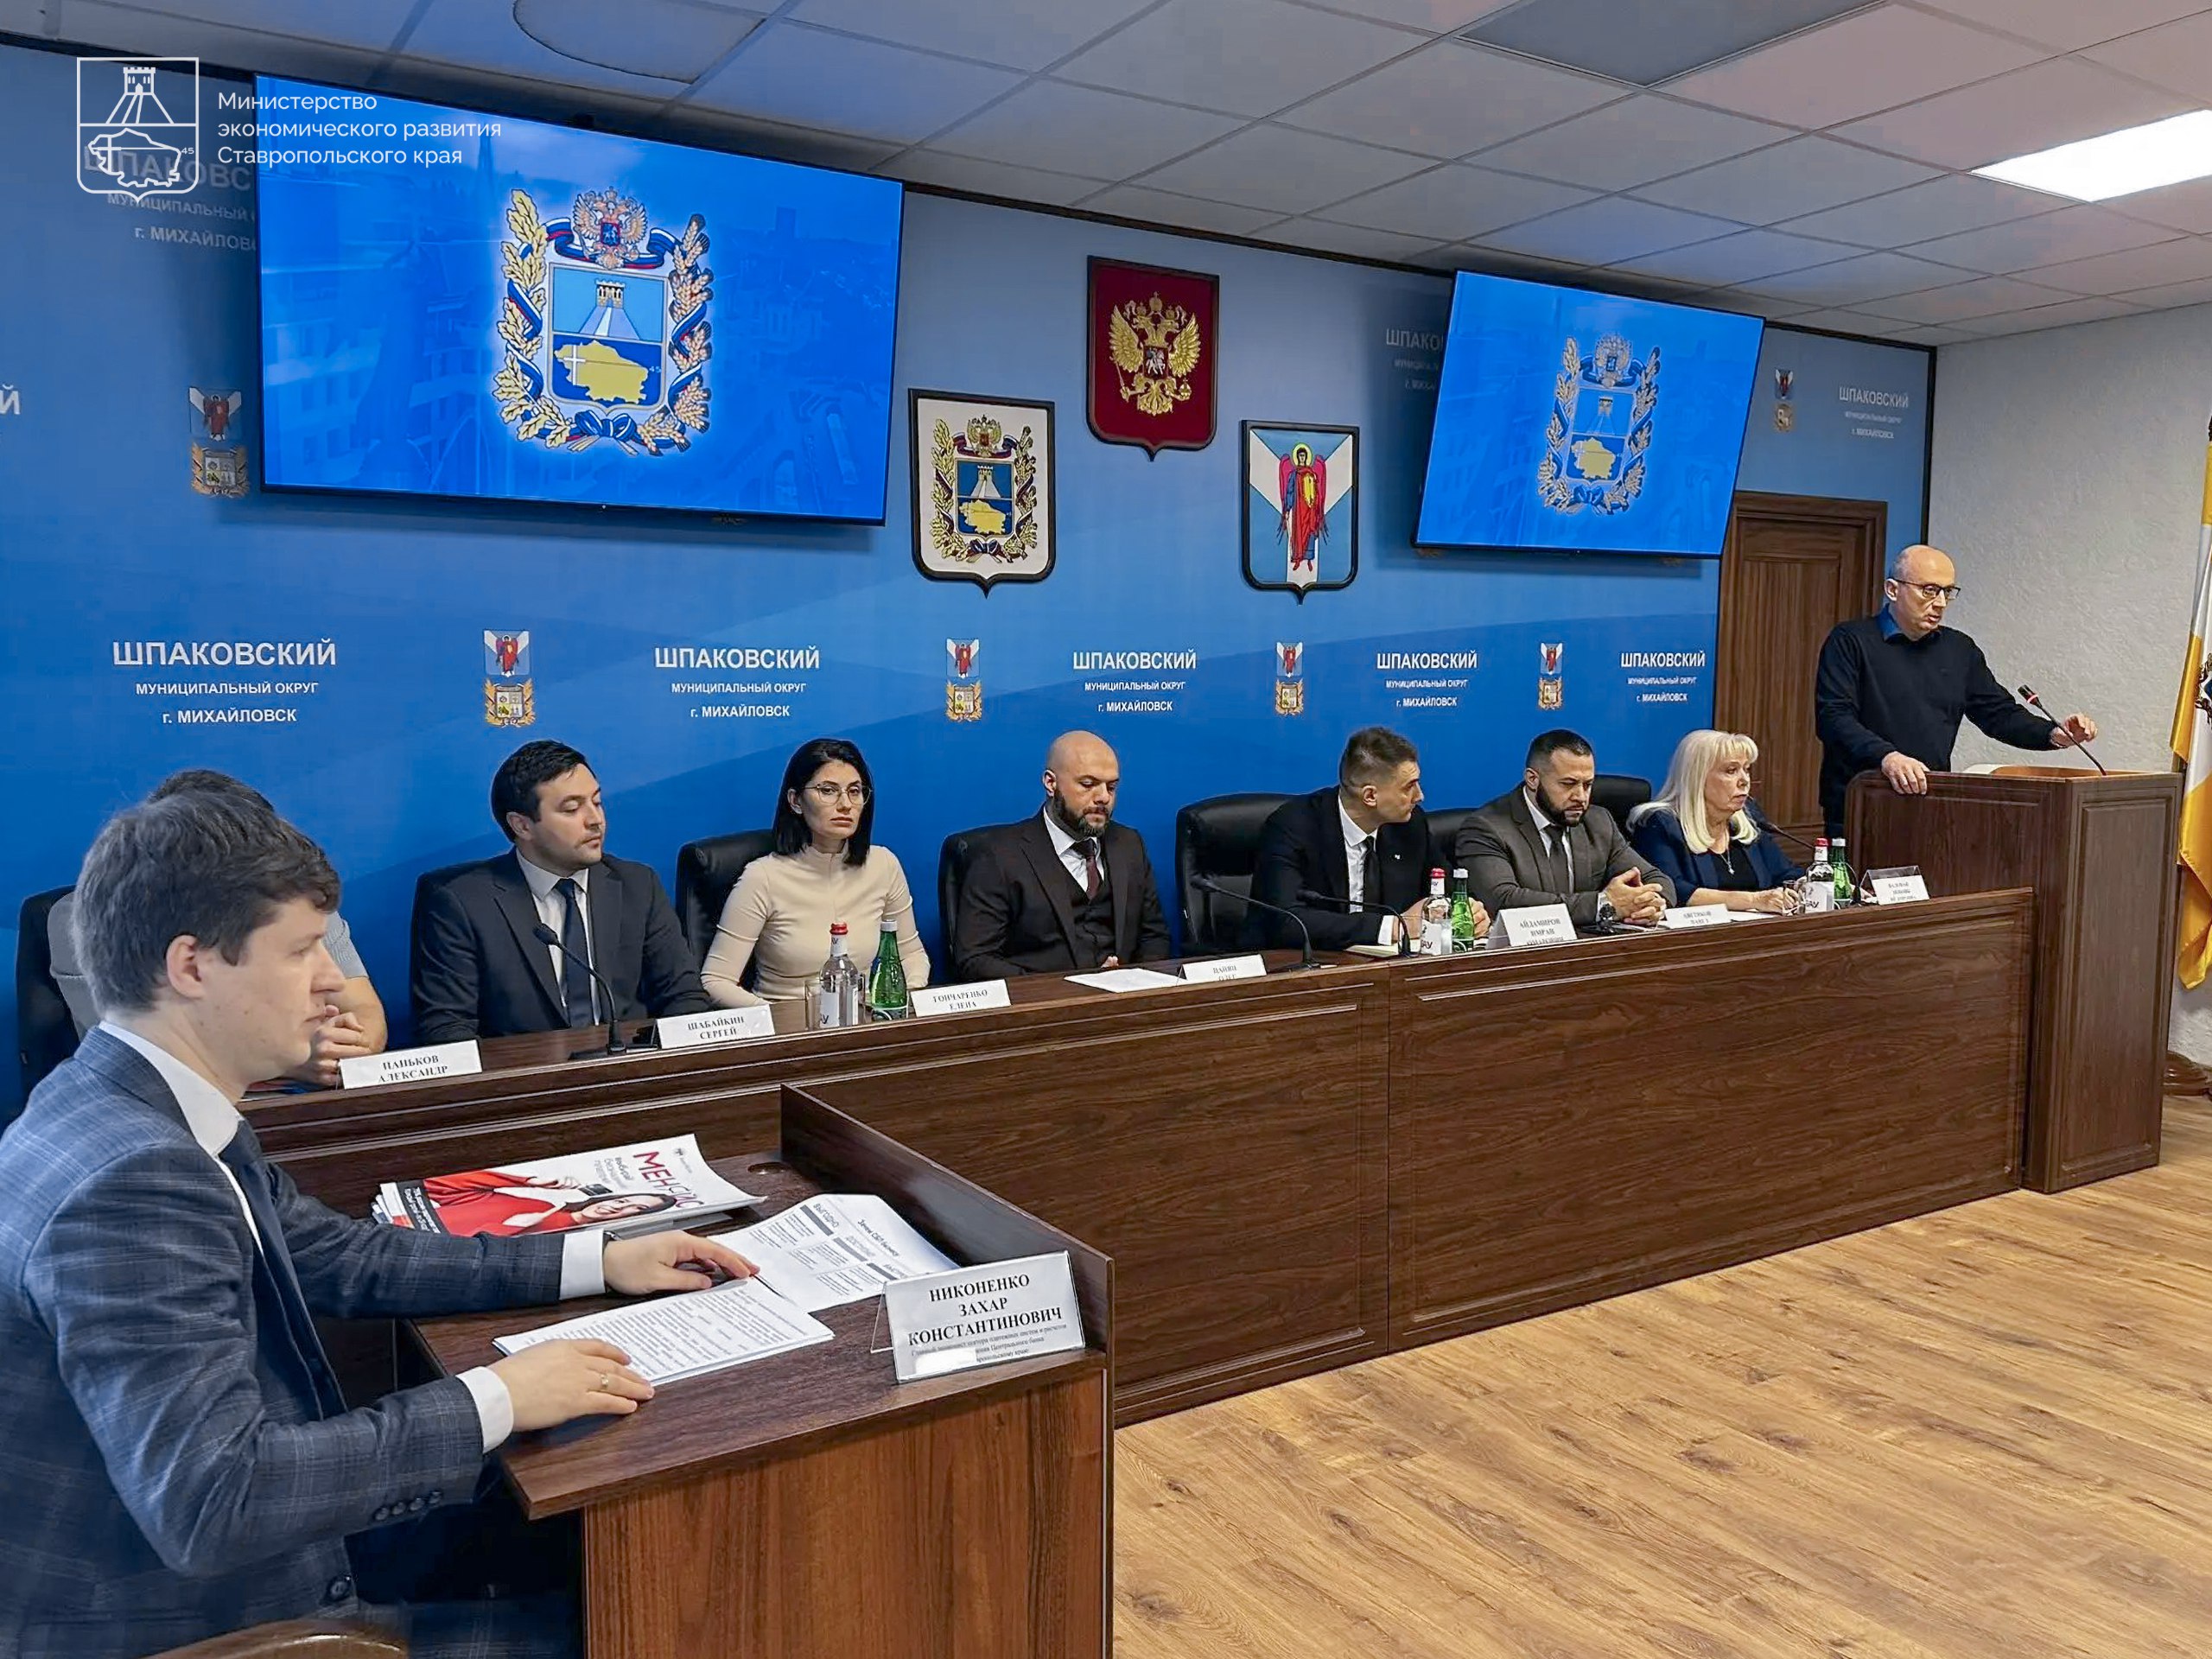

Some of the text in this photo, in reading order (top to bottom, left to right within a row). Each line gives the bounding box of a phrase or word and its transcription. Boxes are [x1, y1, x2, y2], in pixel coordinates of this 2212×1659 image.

[1839, 386, 1909, 408] ШПАКОВСКИЙ
[113, 638, 336, 665] ШПАКОВСКИЙ
[655, 645, 820, 669] ШПАКОВСКИЙ
[1073, 649, 1197, 670] ШПАКОВСКИЙ
[1376, 650, 1478, 669] ШПАКОВСКИЙ
[1620, 650, 1706, 667] ШПАКОВСКИЙ
[136, 681, 319, 696] МУНИЦИПАЛЬНЫЙ ОКРУГ
[671, 682, 807, 694] МУНИЦИПАЛЬНЫЙ ОКРУГ
[1084, 681, 1186, 691] МУНИЦИПАЛЬНЫЙ ОКРУГ
[1106, 700, 1173, 712] МИХАЙЛОВСК
[1402, 696, 1458, 707] МИХАЙЛОВСК
[162, 707, 297, 723] г. МИХАЙЛОВСК
[690, 703, 791, 718] г. МИХАЙЛОВСК
[932, 989, 988, 1003] ГОНЧАРЕНКО
[688, 1016, 745, 1031] ШАБАЙКИН
[699, 1027, 737, 1039] СЕРГЕЙ
[382, 1054, 439, 1071] ПАНЬКОВ
[378, 1065, 448, 1084] АЛЕКСАНДР
[929, 1274, 1030, 1302] НИКОНЕНКО
[958, 1297, 1007, 1317] ЗАХАР
[908, 1306, 1062, 1346] КОНСТАНТИНОВИЧ
